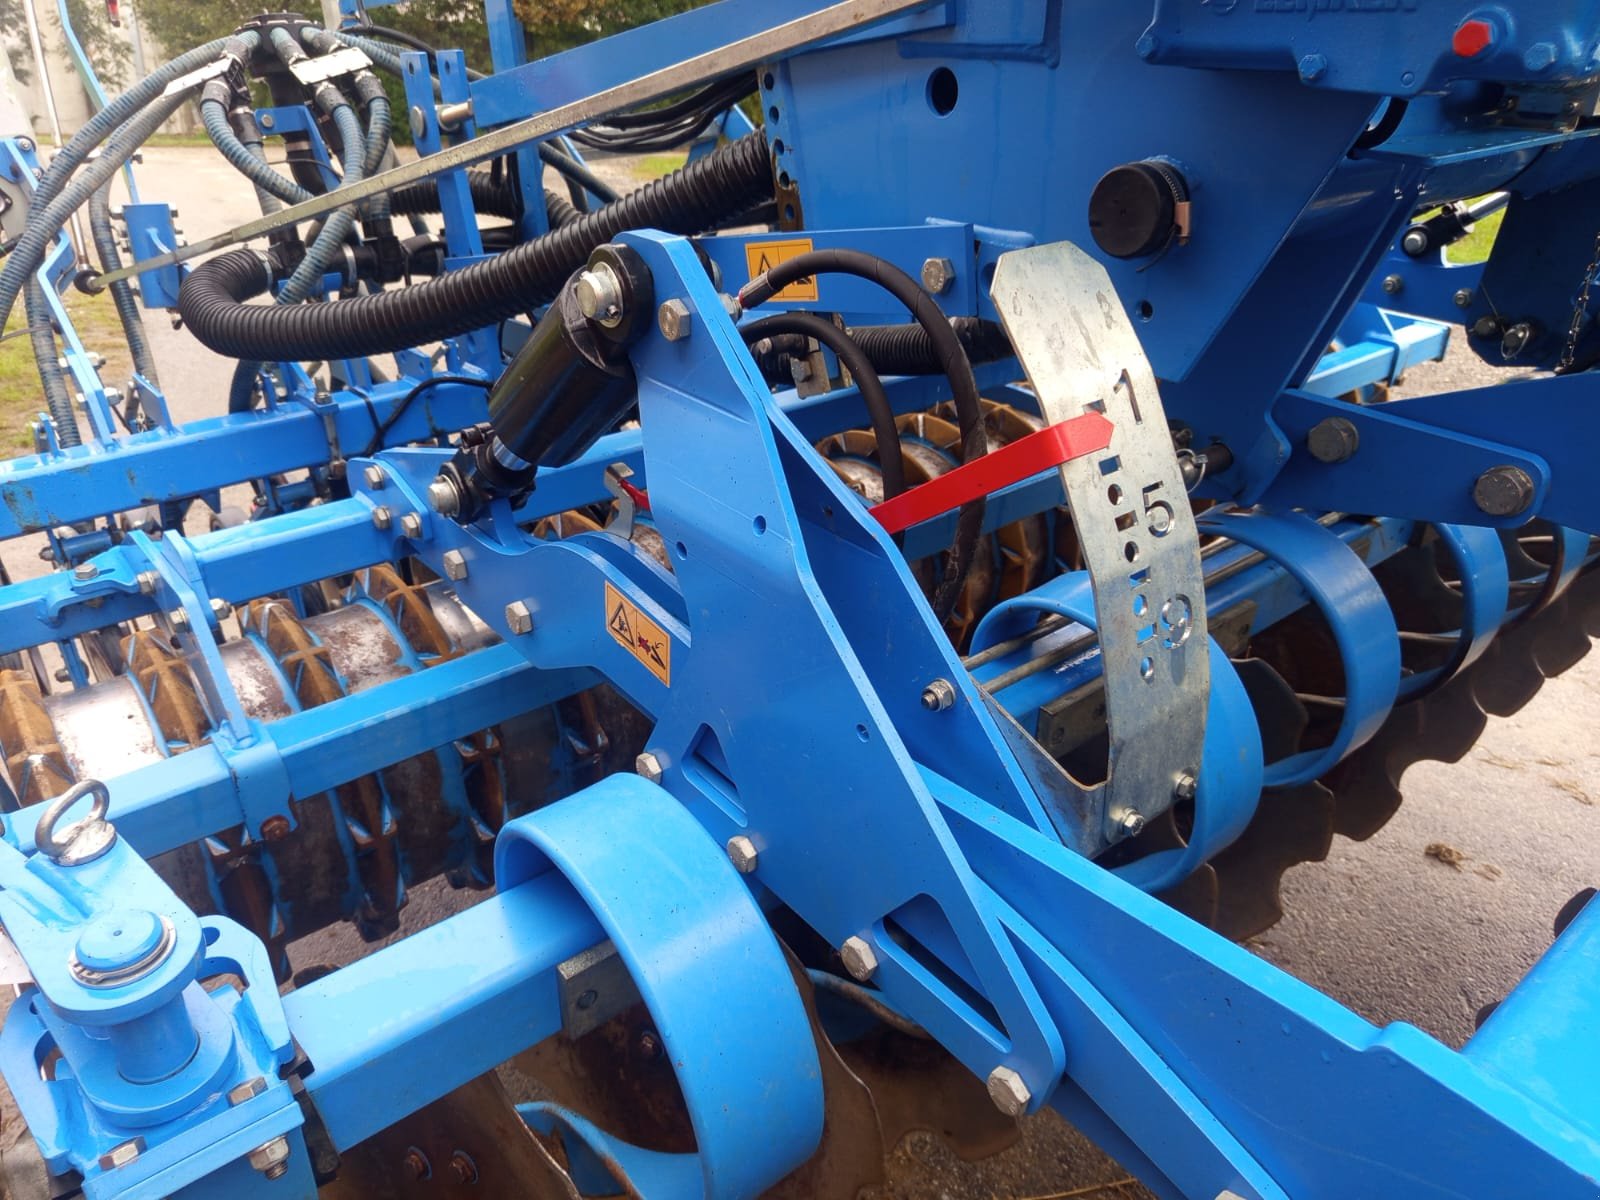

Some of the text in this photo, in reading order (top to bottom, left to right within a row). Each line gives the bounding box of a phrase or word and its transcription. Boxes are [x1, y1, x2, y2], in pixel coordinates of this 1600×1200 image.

[1113, 367, 1143, 426] 1
[1142, 480, 1175, 538] 5
[1159, 593, 1193, 650] 9
